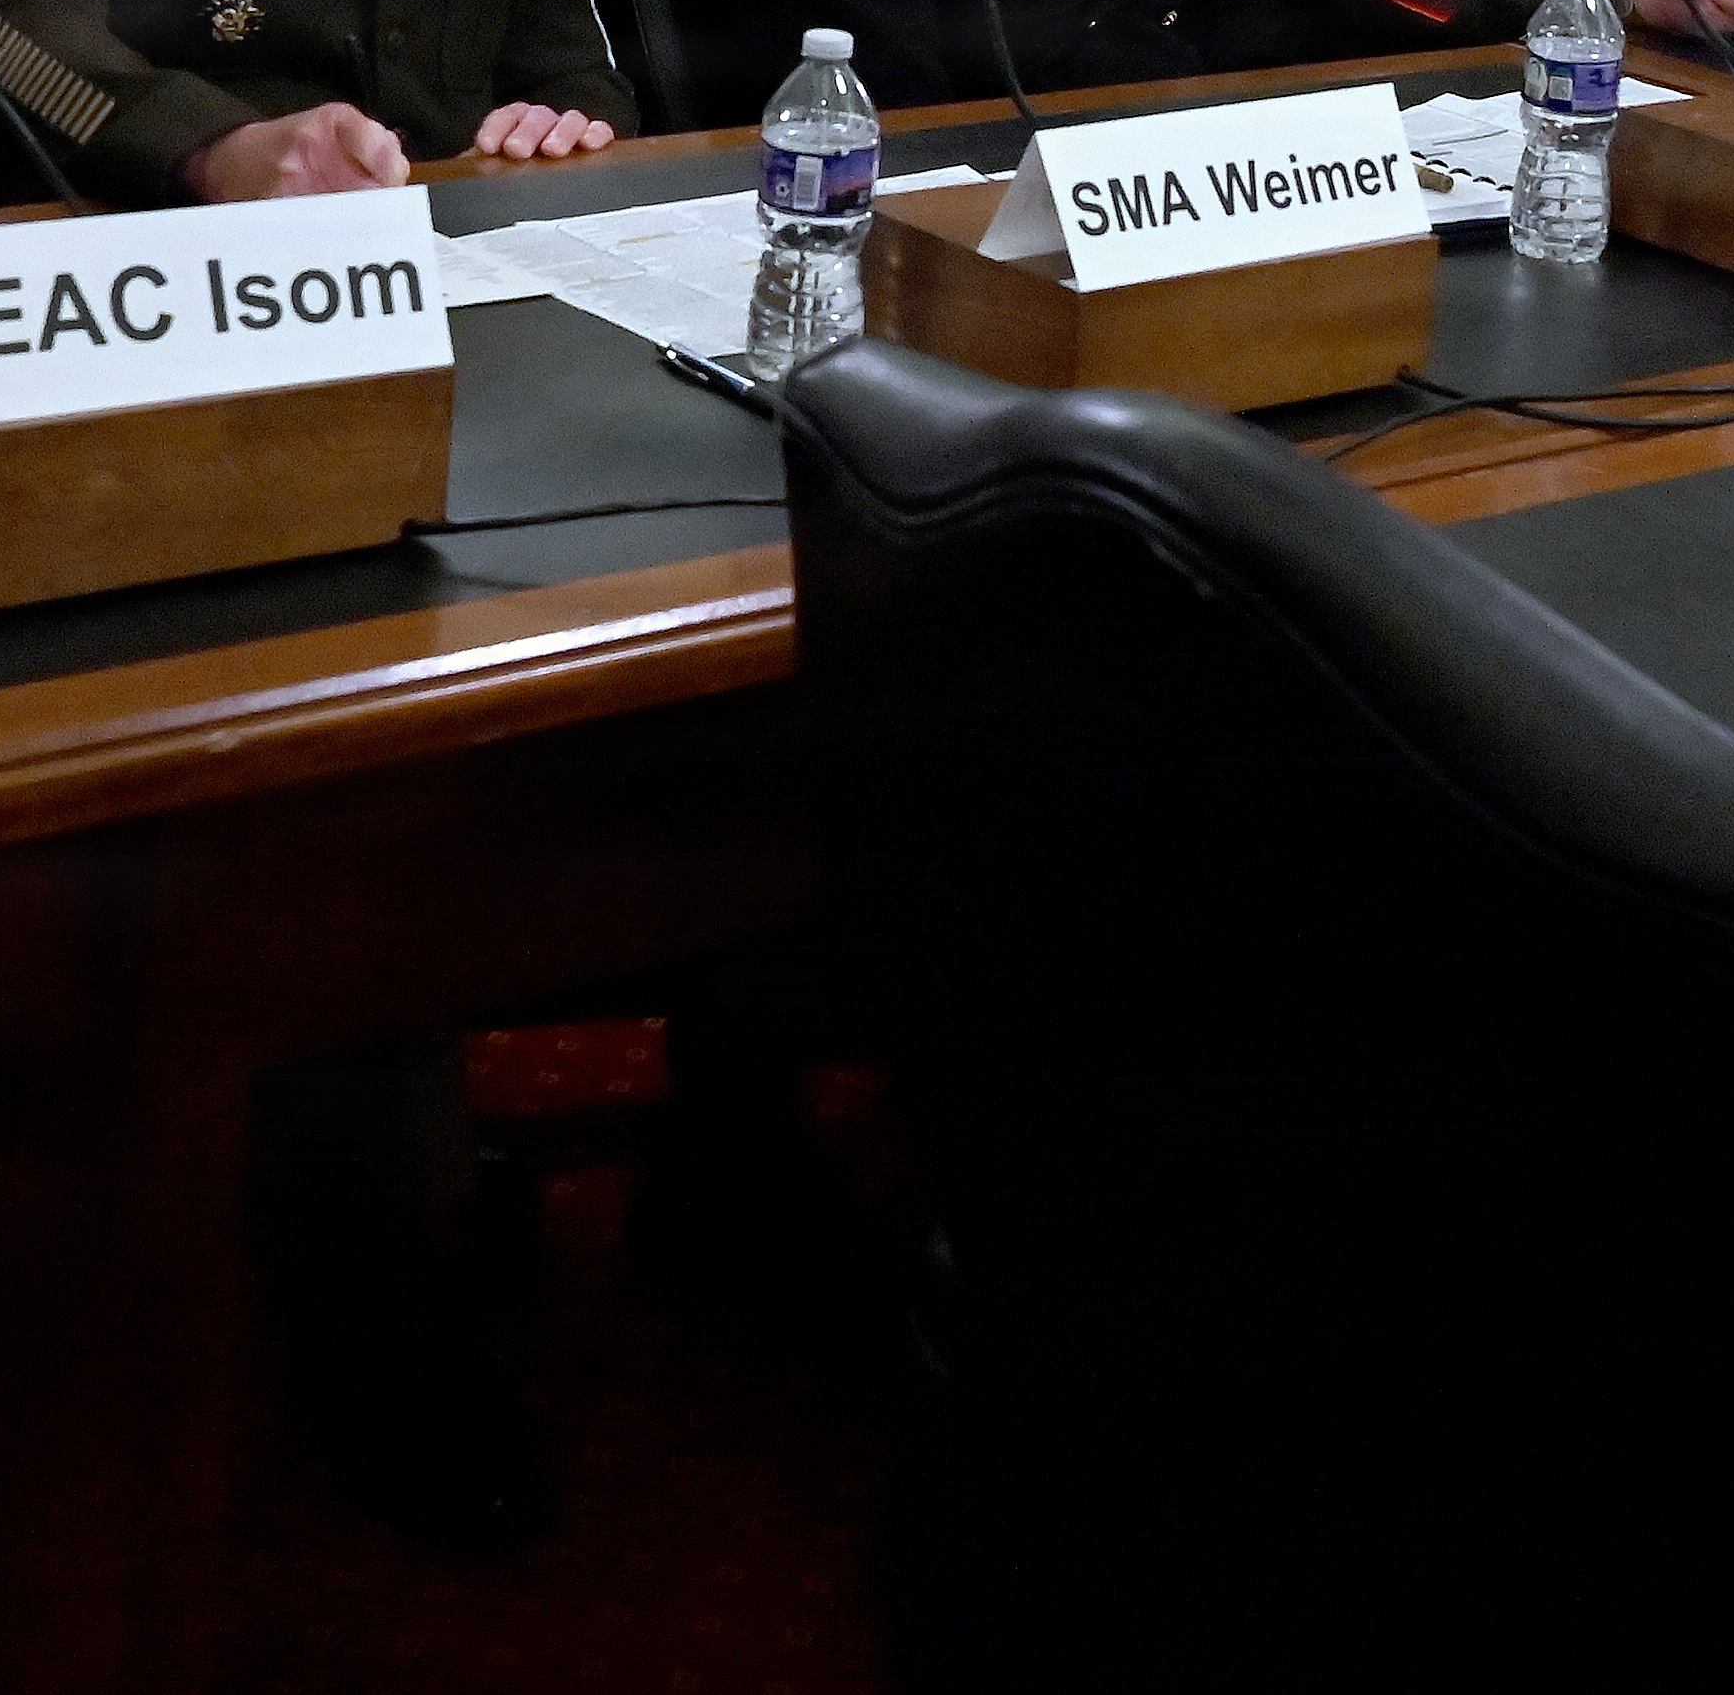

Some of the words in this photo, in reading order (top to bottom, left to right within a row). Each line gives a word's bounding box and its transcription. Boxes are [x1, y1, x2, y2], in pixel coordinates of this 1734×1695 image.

[1071, 169, 1202, 236] SMA
[1206, 152, 1398, 216] Weimer
[206, 255, 424, 335] Isom
